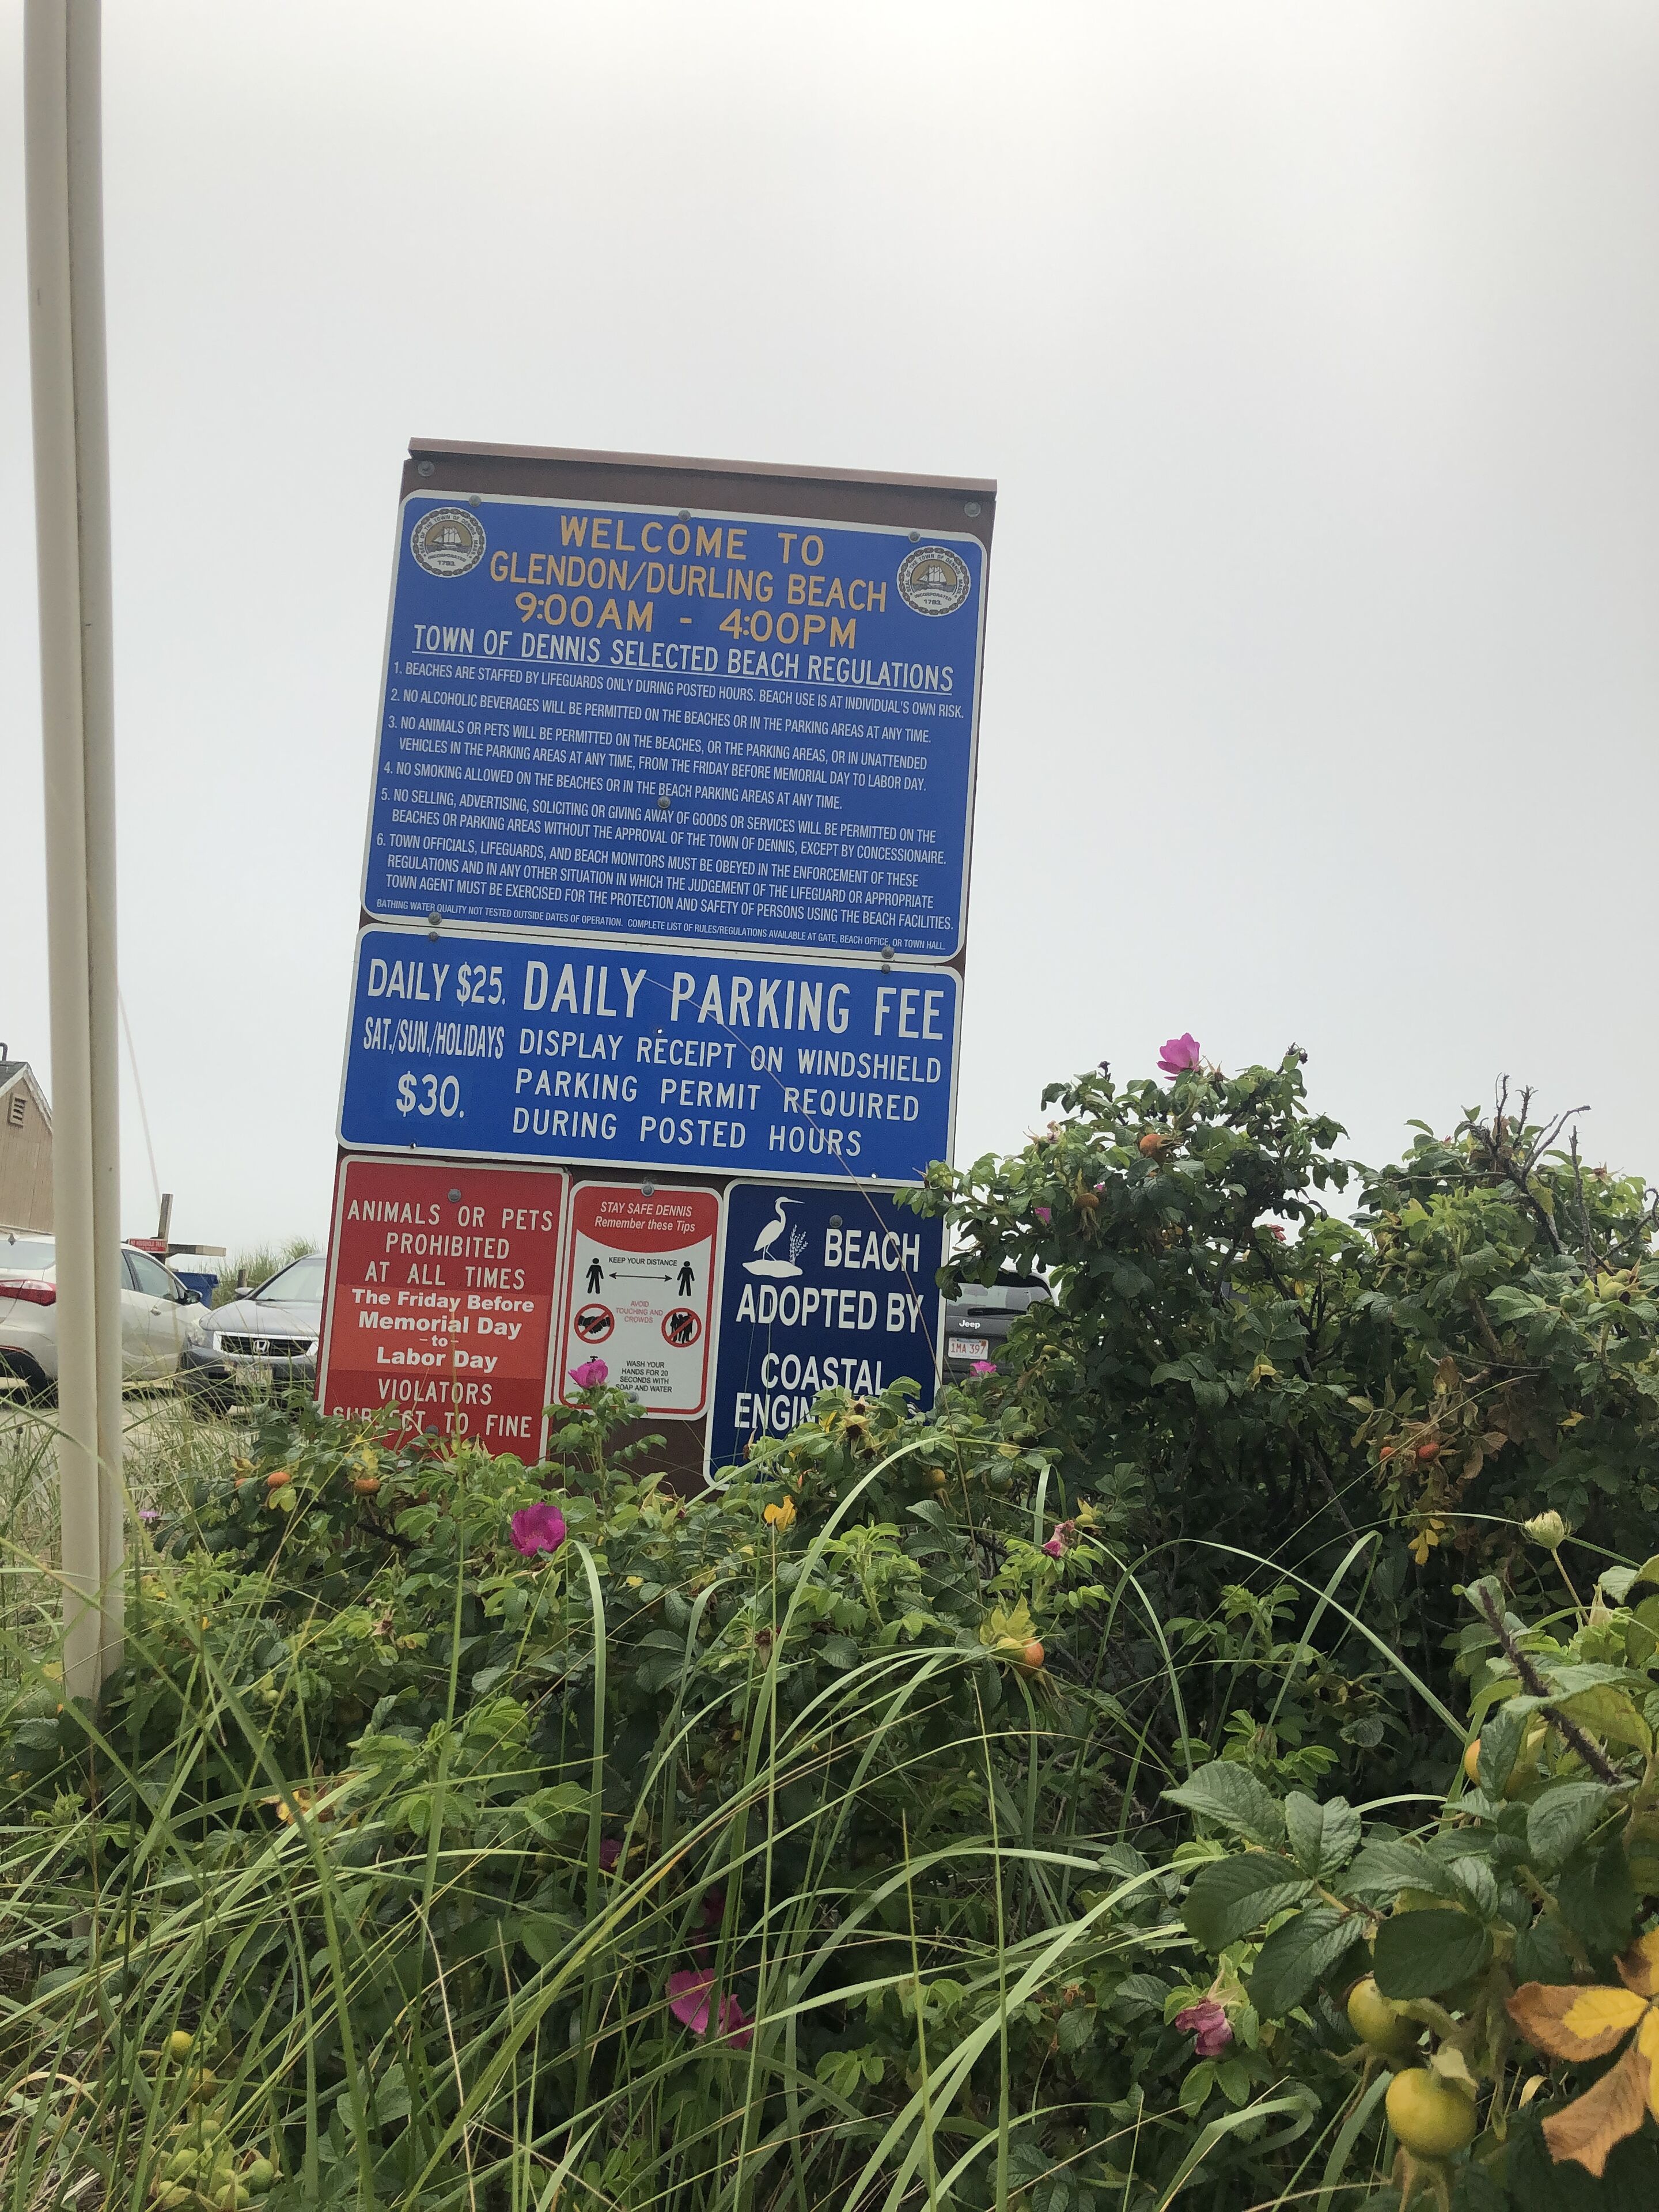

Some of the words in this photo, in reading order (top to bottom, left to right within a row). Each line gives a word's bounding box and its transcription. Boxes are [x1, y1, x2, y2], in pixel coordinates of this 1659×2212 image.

[560, 516, 747, 560] WELCOME
[778, 532, 824, 566] TO
[490, 550, 773, 603] GLENDON/DURLING
[787, 573, 887, 612] BEACH
[515, 592, 654, 632] 9:00AM
[719, 608, 857, 649] 4:00PM
[414, 624, 475, 653] TOWN
[483, 629, 513, 656] OF
[521, 632, 601, 663] DENNIS
[610, 639, 718, 672] SELECTED
[728, 649, 799, 679] BEACH
[808, 655, 953, 691] REGULATIONS
[394, 661, 402, 674] 1.
[406, 662, 453, 678] BEACHES
[454, 665, 476, 680] ARE
[478, 667, 523, 683] STAFFED
[525, 671, 539, 684] BY
[541, 672, 604, 690] LIFEGUARDS
[606, 677, 634, 692] ONLY
[635, 679, 674, 695] DURING
[676, 683, 716, 698] POSTED
[719, 686, 756, 702] HOURS.
[759, 689, 793, 704] BEACH
[795, 692, 815, 706] USE
[817, 694, 827, 707] IS
[829, 695, 843, 709] AT
[845, 696, 910, 714] INDIVIDUAL'S
[912, 702, 936, 716] OWN
[938, 704, 964, 718] RISK.
[386, 874, 417, 889] TOWN
[419, 877, 454, 892] AGENT
[456, 880, 487, 895] MUST
[489, 882, 503, 896] BE
[505, 884, 562, 901] EXERCISED
[565, 888, 585, 903] FOR
[588, 890, 608, 904] THE
[610, 892, 673, 910] PROTECTION
[676, 897, 698, 911] AND
[700, 899, 739, 914] SAFETY
[741, 902, 755, 915] OF
[757, 903, 804, 919] PERSONS
[807, 907, 838, 922] USING
[840, 909, 860, 923] THE
[862, 911, 896, 926] BEACH
[899, 913, 953, 930] FACILITIES.
[377, 899, 408, 910] BATHING
[410, 902, 435, 911] WATER
[437, 903, 467, 914] QUALITY
[468, 906, 484, 915] NOT
[485, 907, 512, 918] TESTED
[513, 910, 544, 921] OUTSIDE
[546, 912, 569, 922] DATES
[570, 914, 580, 923] OF
[581, 915, 623, 926] OPERATION.
[628, 918, 665, 930] COMPLETE
[666, 922, 683, 931] LIST
[683, 923, 693, 931] OF
[695, 924, 767, 938] RULES/REGULATIONS
[768, 929, 806, 940] AVAILABLE
[806, 932, 817, 941] AT
[818, 933, 838, 944] GATE,
[839, 934, 863, 944] BEACH
[865, 936, 891, 946] OFFICE,
[892, 938, 902, 947] OR
[904, 939, 925, 949] TOWN
[368, 959, 450, 1002] DAILY
[456, 963, 505, 1005] $25.
[523, 960, 647, 1018] DAILY
[671, 972, 850, 1034] PARKING
[874, 986, 944, 1040] FEE
[520, 1028, 623, 1060] DISPLAY
[637, 1036, 737, 1068] RECEIPT
[749, 1044, 783, 1073] ON
[798, 1048, 941, 1083] WINDSHIELD
[396, 1070, 464, 1118] $30.
[516, 1068, 638, 1102] PARKING
[660, 1078, 761, 1110] PERMIT
[783, 1087, 919, 1122] REQUIRED
[513, 1108, 617, 1140] DURING
[640, 1116, 745, 1148] POSTED
[769, 1125, 861, 1157] HOURS
[347, 1199, 441, 1225] ANIMALS
[458, 1205, 485, 1228] OR
[502, 1208, 553, 1232] PETS
[594, 1215, 646, 1229] Remember
[647, 1218, 673, 1230] these
[676, 1220, 696, 1234] Tips
[600, 1201, 626, 1213] STAY
[627, 1203, 654, 1215] SAFE
[655, 1204, 692, 1217] DENNIS
[385, 1232, 509, 1259] PROHIBITED
[824, 1228, 920, 1273] BEACH
[365, 1260, 390, 1282] AT
[407, 1263, 446, 1286] ALL
[465, 1266, 525, 1290] TIMES
[646, 1259, 677, 1267] DISTANCE
[351, 1288, 391, 1305] The
[397, 1291, 461, 1312] Friday
[467, 1294, 535, 1312] Before
[616, 1307, 648, 1316] TOUCHING
[736, 1283, 877, 1330] ADOPTED
[886, 1293, 924, 1333] BY
[359, 1310, 469, 1334] Memorial
[477, 1317, 522, 1340] Day
[624, 1316, 653, 1324] CROWDS
[959, 1320, 980, 1329] Jeep
[431, 1335, 448, 1347] to
[969, 1344, 986, 1355] 397
[377, 1346, 446, 1366] Labor
[453, 1350, 498, 1373] Day
[622, 1368, 645, 1376] HANDS
[761, 1352, 884, 1397] COASTAL
[378, 1378, 493, 1406] VIOLATORS
[619, 1376, 651, 1384] SECONDS
[444, 1412, 469, 1434] TO
[486, 1414, 532, 1438] FINE
